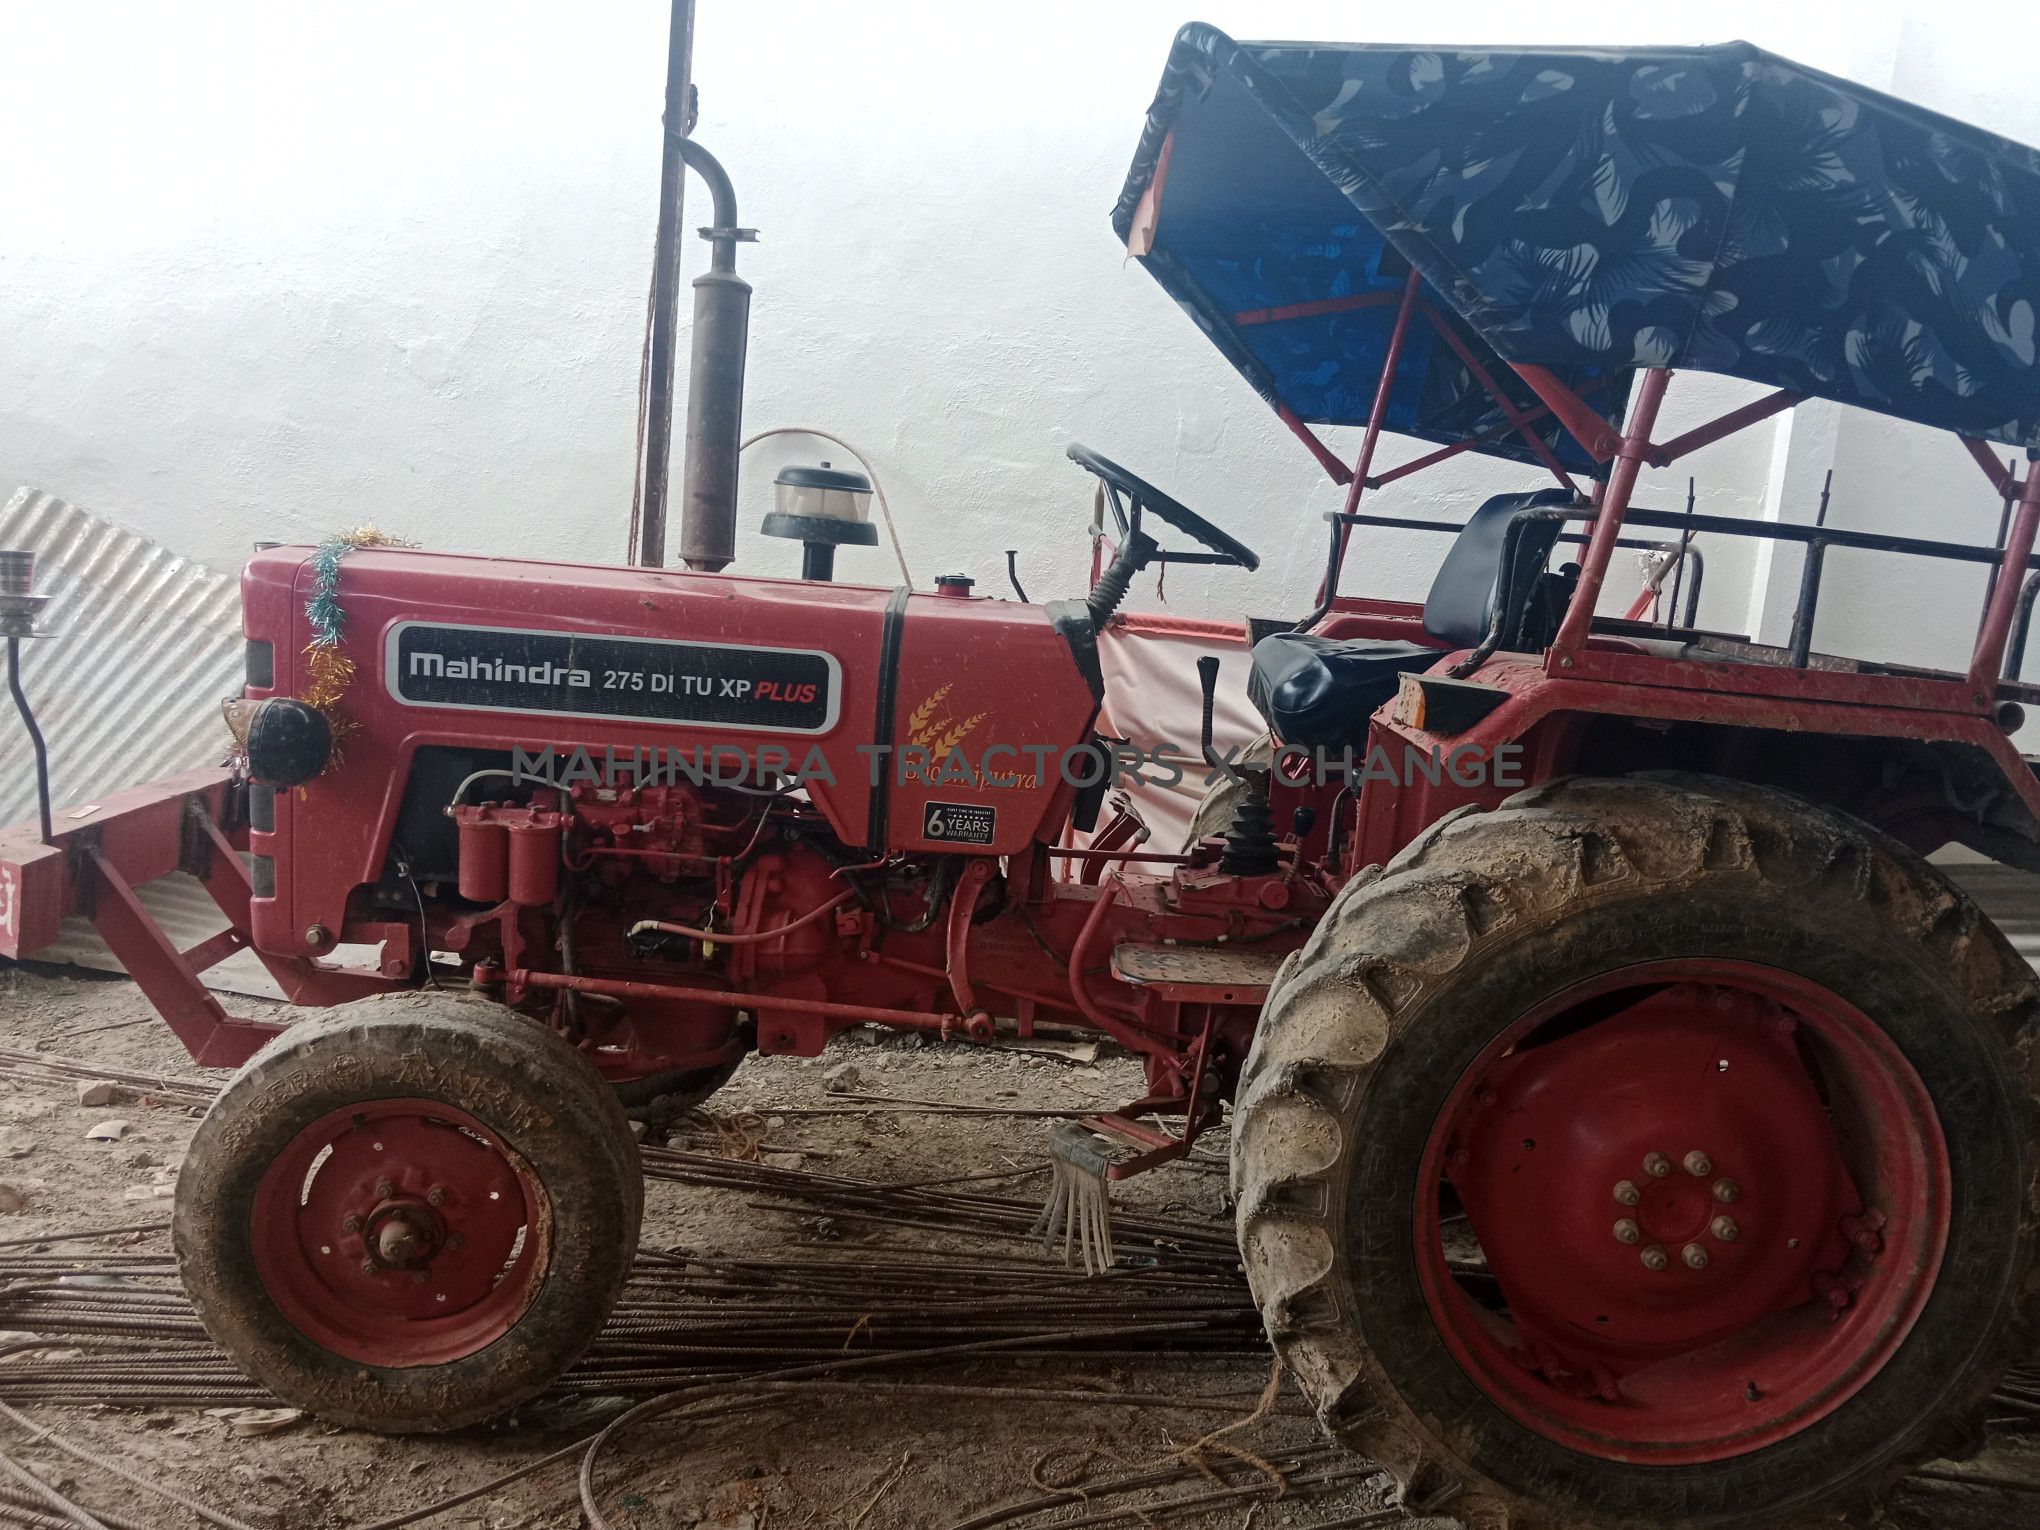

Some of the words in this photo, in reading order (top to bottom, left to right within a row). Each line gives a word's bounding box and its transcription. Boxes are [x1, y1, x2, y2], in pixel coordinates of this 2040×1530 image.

[603, 670, 644, 691] 275
[651, 672, 675, 694] DI
[684, 675, 713, 696] TU
[719, 677, 751, 699] XP
[754, 681, 817, 704] PLUS
[927, 809, 945, 837] 6
[946, 829, 989, 839] WARRANTY
